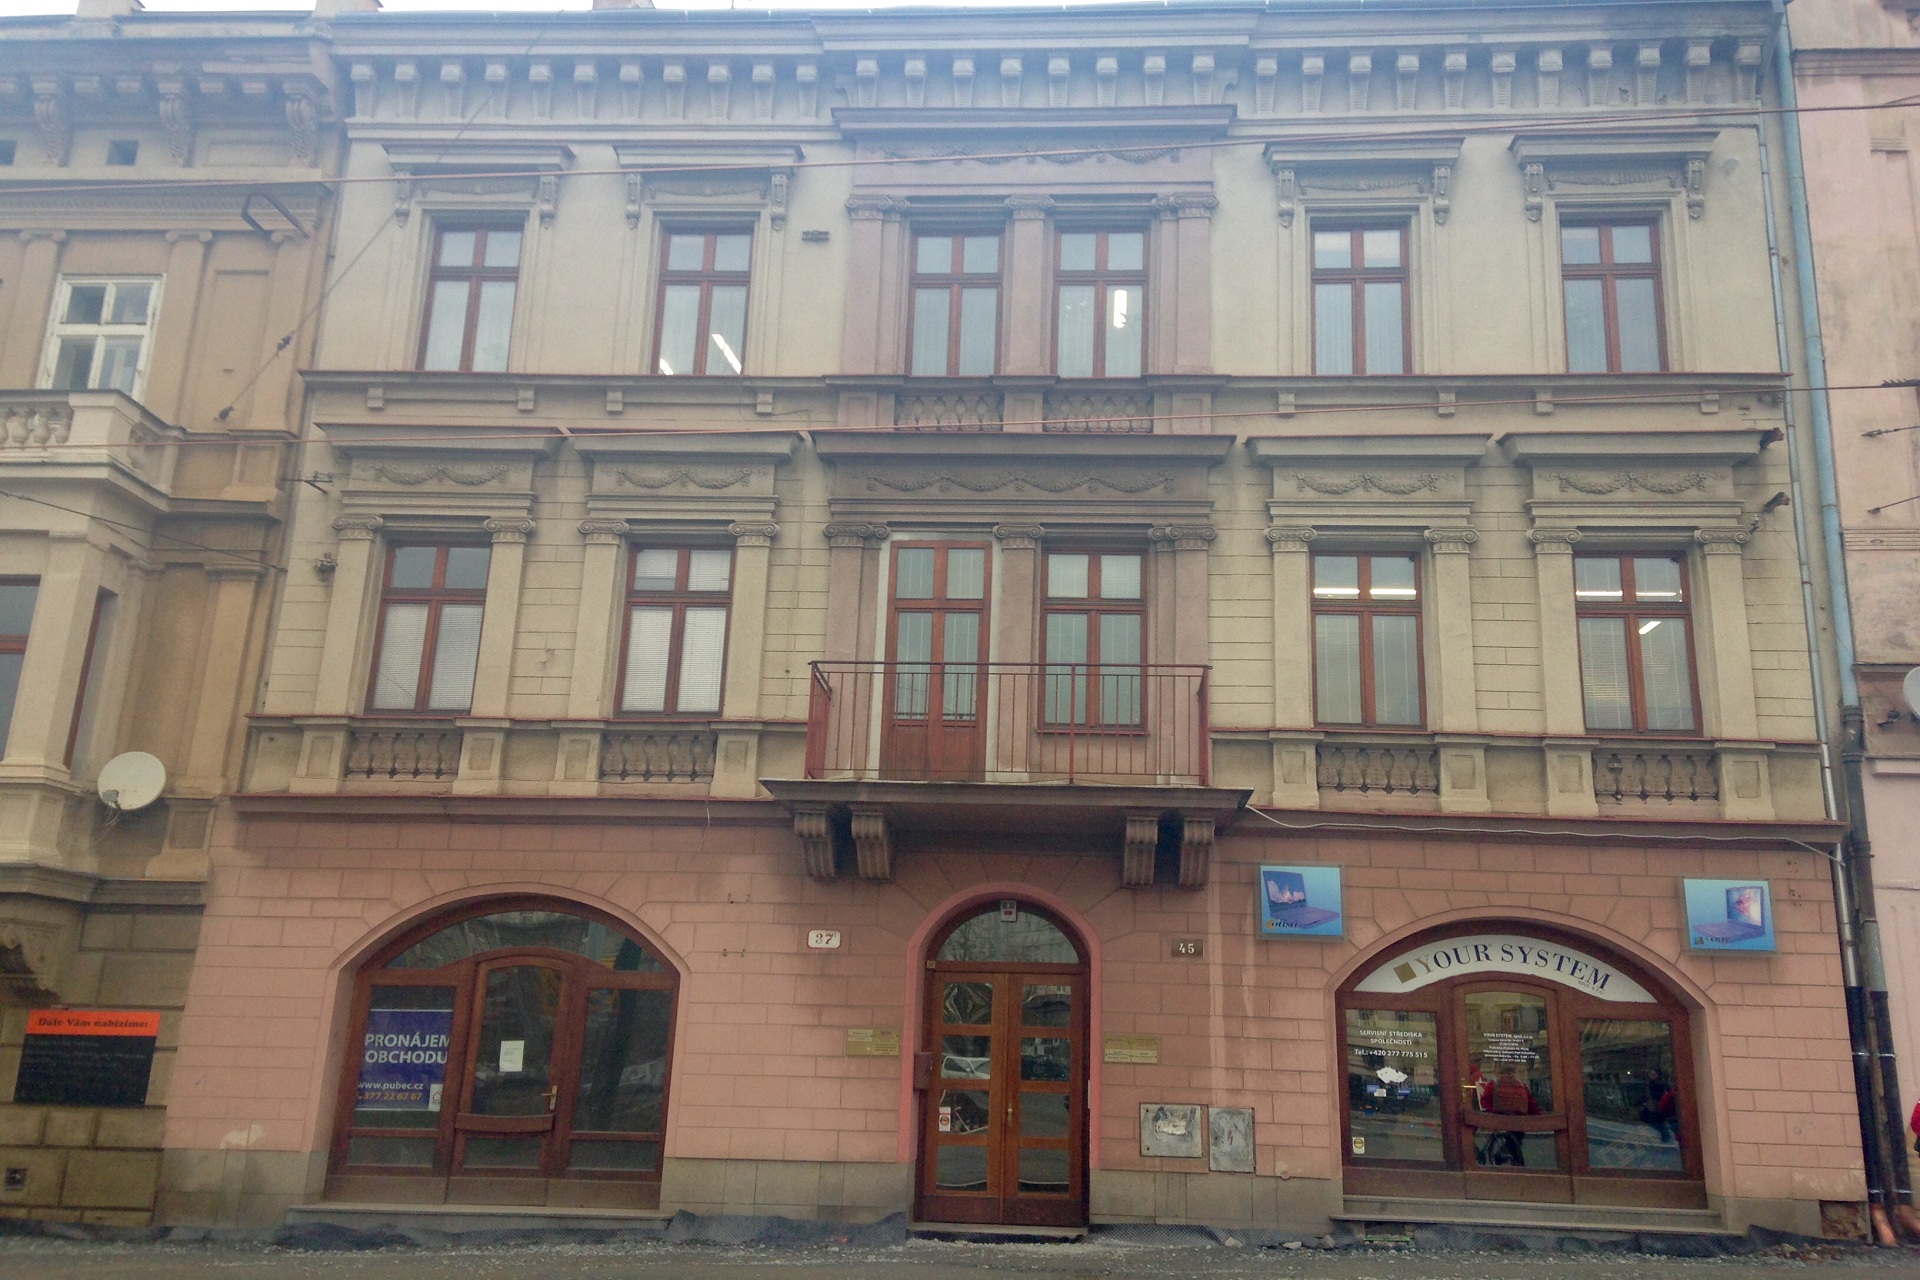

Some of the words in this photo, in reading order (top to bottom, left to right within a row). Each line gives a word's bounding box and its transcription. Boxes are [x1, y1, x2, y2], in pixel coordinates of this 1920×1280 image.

[814, 933, 834, 945] 37
[1178, 942, 1195, 954] 45
[1413, 943, 1492, 975] YOUR
[1500, 943, 1613, 991] SYSTEM
[1388, 1030, 1423, 1038] STŘEDISKA
[364, 1050, 448, 1064] OBCHODU
[364, 1091, 381, 1100] 377
